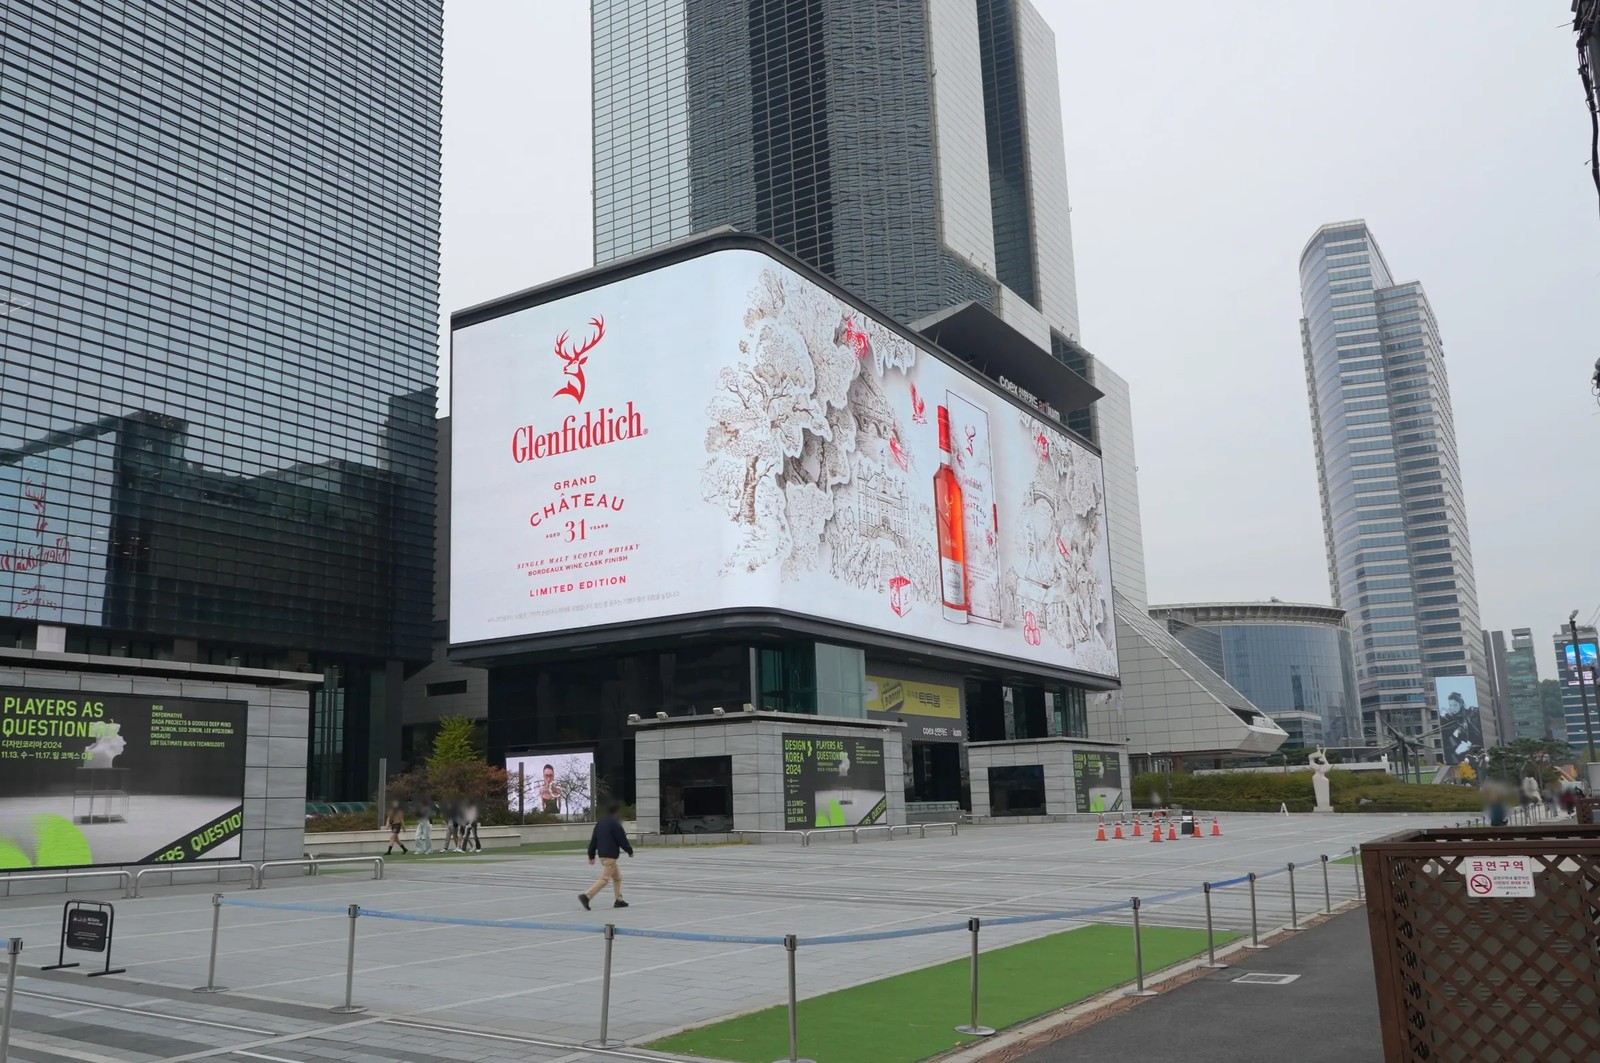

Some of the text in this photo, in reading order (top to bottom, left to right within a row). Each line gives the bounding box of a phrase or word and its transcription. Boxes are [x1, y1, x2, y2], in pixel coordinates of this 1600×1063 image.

[1000, 375, 1018, 396] coex
[512, 401, 643, 463] Glenfiddich
[553, 474, 597, 491] GRAND
[530, 493, 625, 527] CHÂTEAU
[564, 518, 586, 543] 31
[517, 543, 640, 570] SINGLE MALT SCOTCH WHISKY
[528, 555, 628, 577] BORDEAUX WINE CASK FINISH
[529, 575, 627, 597] LIMITED EDITION
[4, 697, 104, 718] PLAYERS AS
[43, 741, 62, 749] 2024
[785, 739, 806, 751] DESIGN
[816, 740, 843, 750] PLAYERS AS
[785, 752, 805, 763] KOREA
[786, 764, 802, 775] 2024
[1472, 860, 1524, 872] 금연구역
